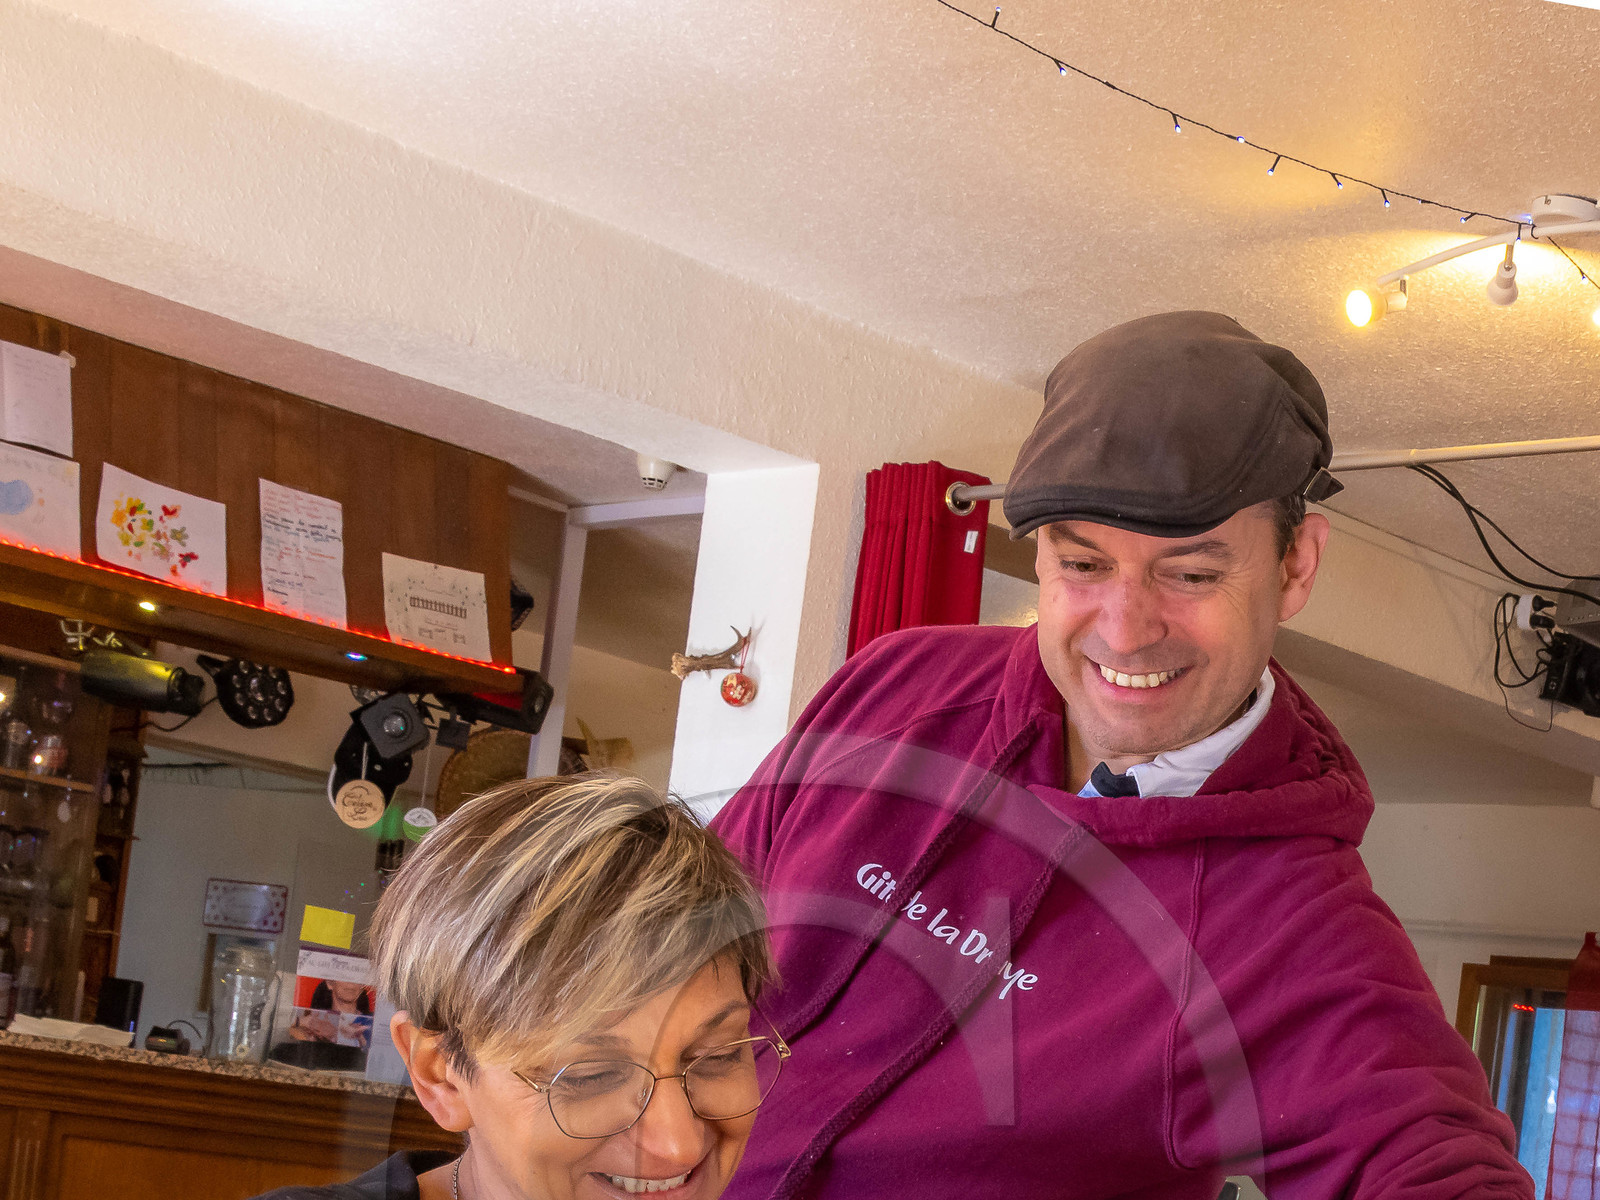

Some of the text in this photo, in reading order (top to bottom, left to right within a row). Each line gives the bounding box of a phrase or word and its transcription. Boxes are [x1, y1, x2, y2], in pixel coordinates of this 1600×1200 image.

[856, 863, 898, 903] Git
[926, 907, 961, 945] la
[959, 928, 1039, 1000] Drye
